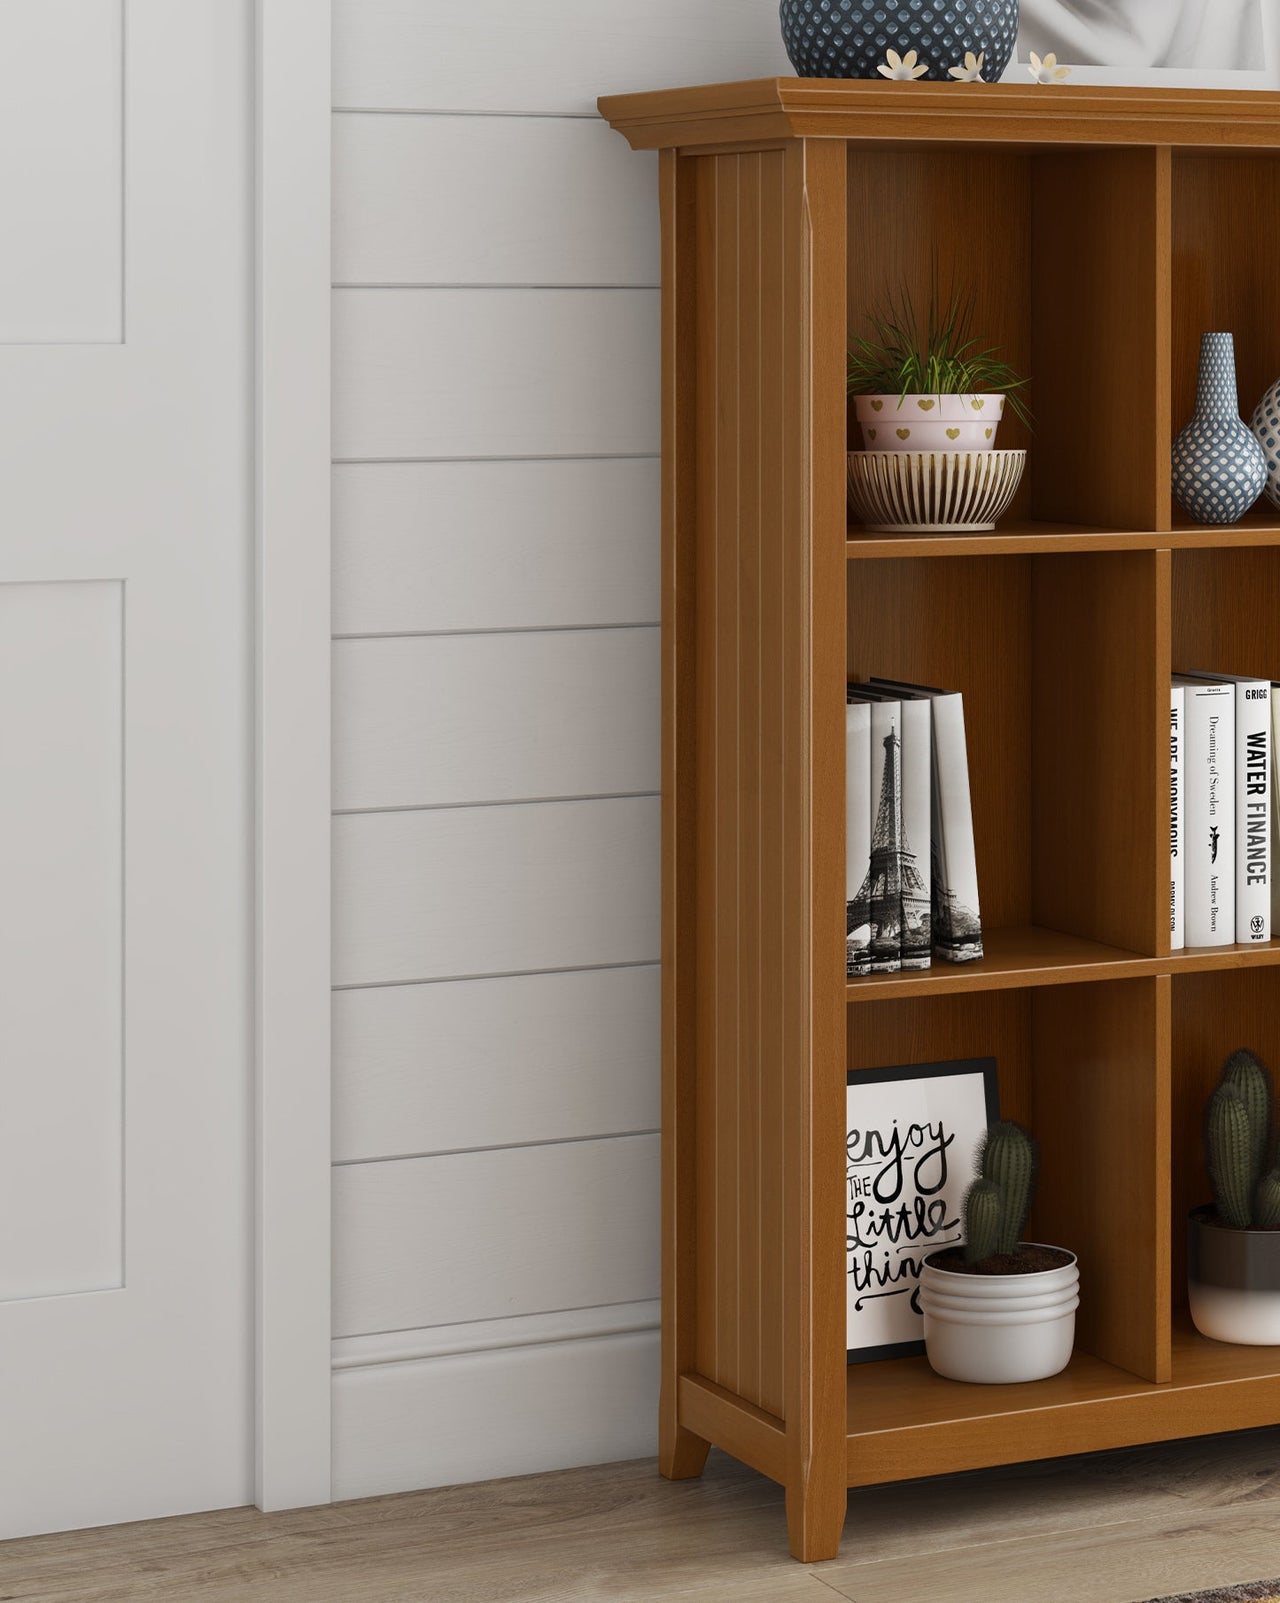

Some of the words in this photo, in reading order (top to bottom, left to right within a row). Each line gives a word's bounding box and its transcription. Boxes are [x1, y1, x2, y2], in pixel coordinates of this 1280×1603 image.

[1245, 689, 1268, 700] GRIGG
[1207, 716, 1220, 764] Dreaming
[1209, 765, 1220, 776] of
[1246, 731, 1267, 796] WATER
[1209, 777, 1220, 816] Sweden
[1246, 803, 1267, 886] FINANCE
[1211, 874, 1219, 904] Andrew
[1211, 906, 1219, 932] Brown
[847, 1119, 955, 1204] enjoy
[847, 1174, 871, 1200] THE
[847, 1196, 960, 1252] Little
